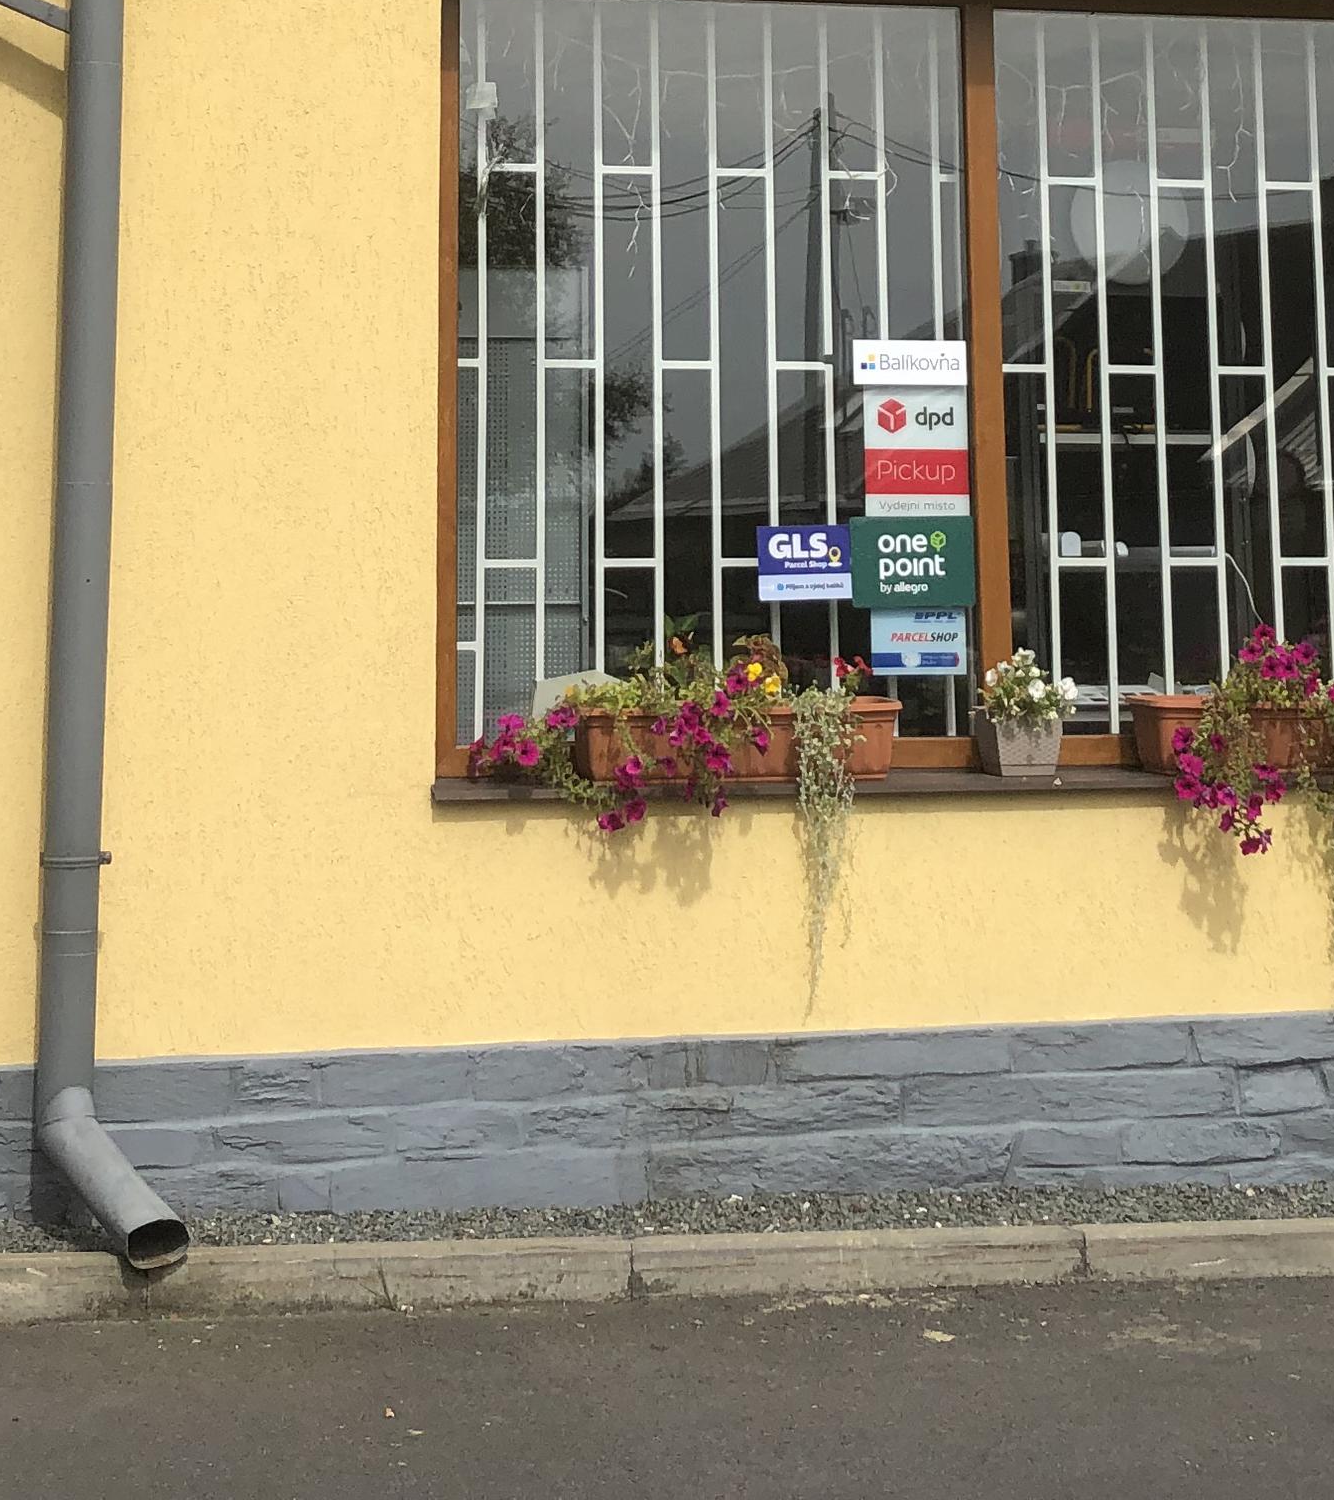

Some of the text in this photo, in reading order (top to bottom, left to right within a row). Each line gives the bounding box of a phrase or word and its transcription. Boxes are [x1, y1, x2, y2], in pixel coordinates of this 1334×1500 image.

[915, 406, 954, 431] dpd
[877, 460, 956, 485] Pickup
[768, 532, 828, 559] GLS
[878, 534, 928, 553] one
[784, 561, 807, 569] Parcel
[879, 554, 946, 580] point
[880, 582, 929, 594] by allegro
[924, 611, 958, 620] PPL
[891, 631, 959, 642] PARCELSHOP
